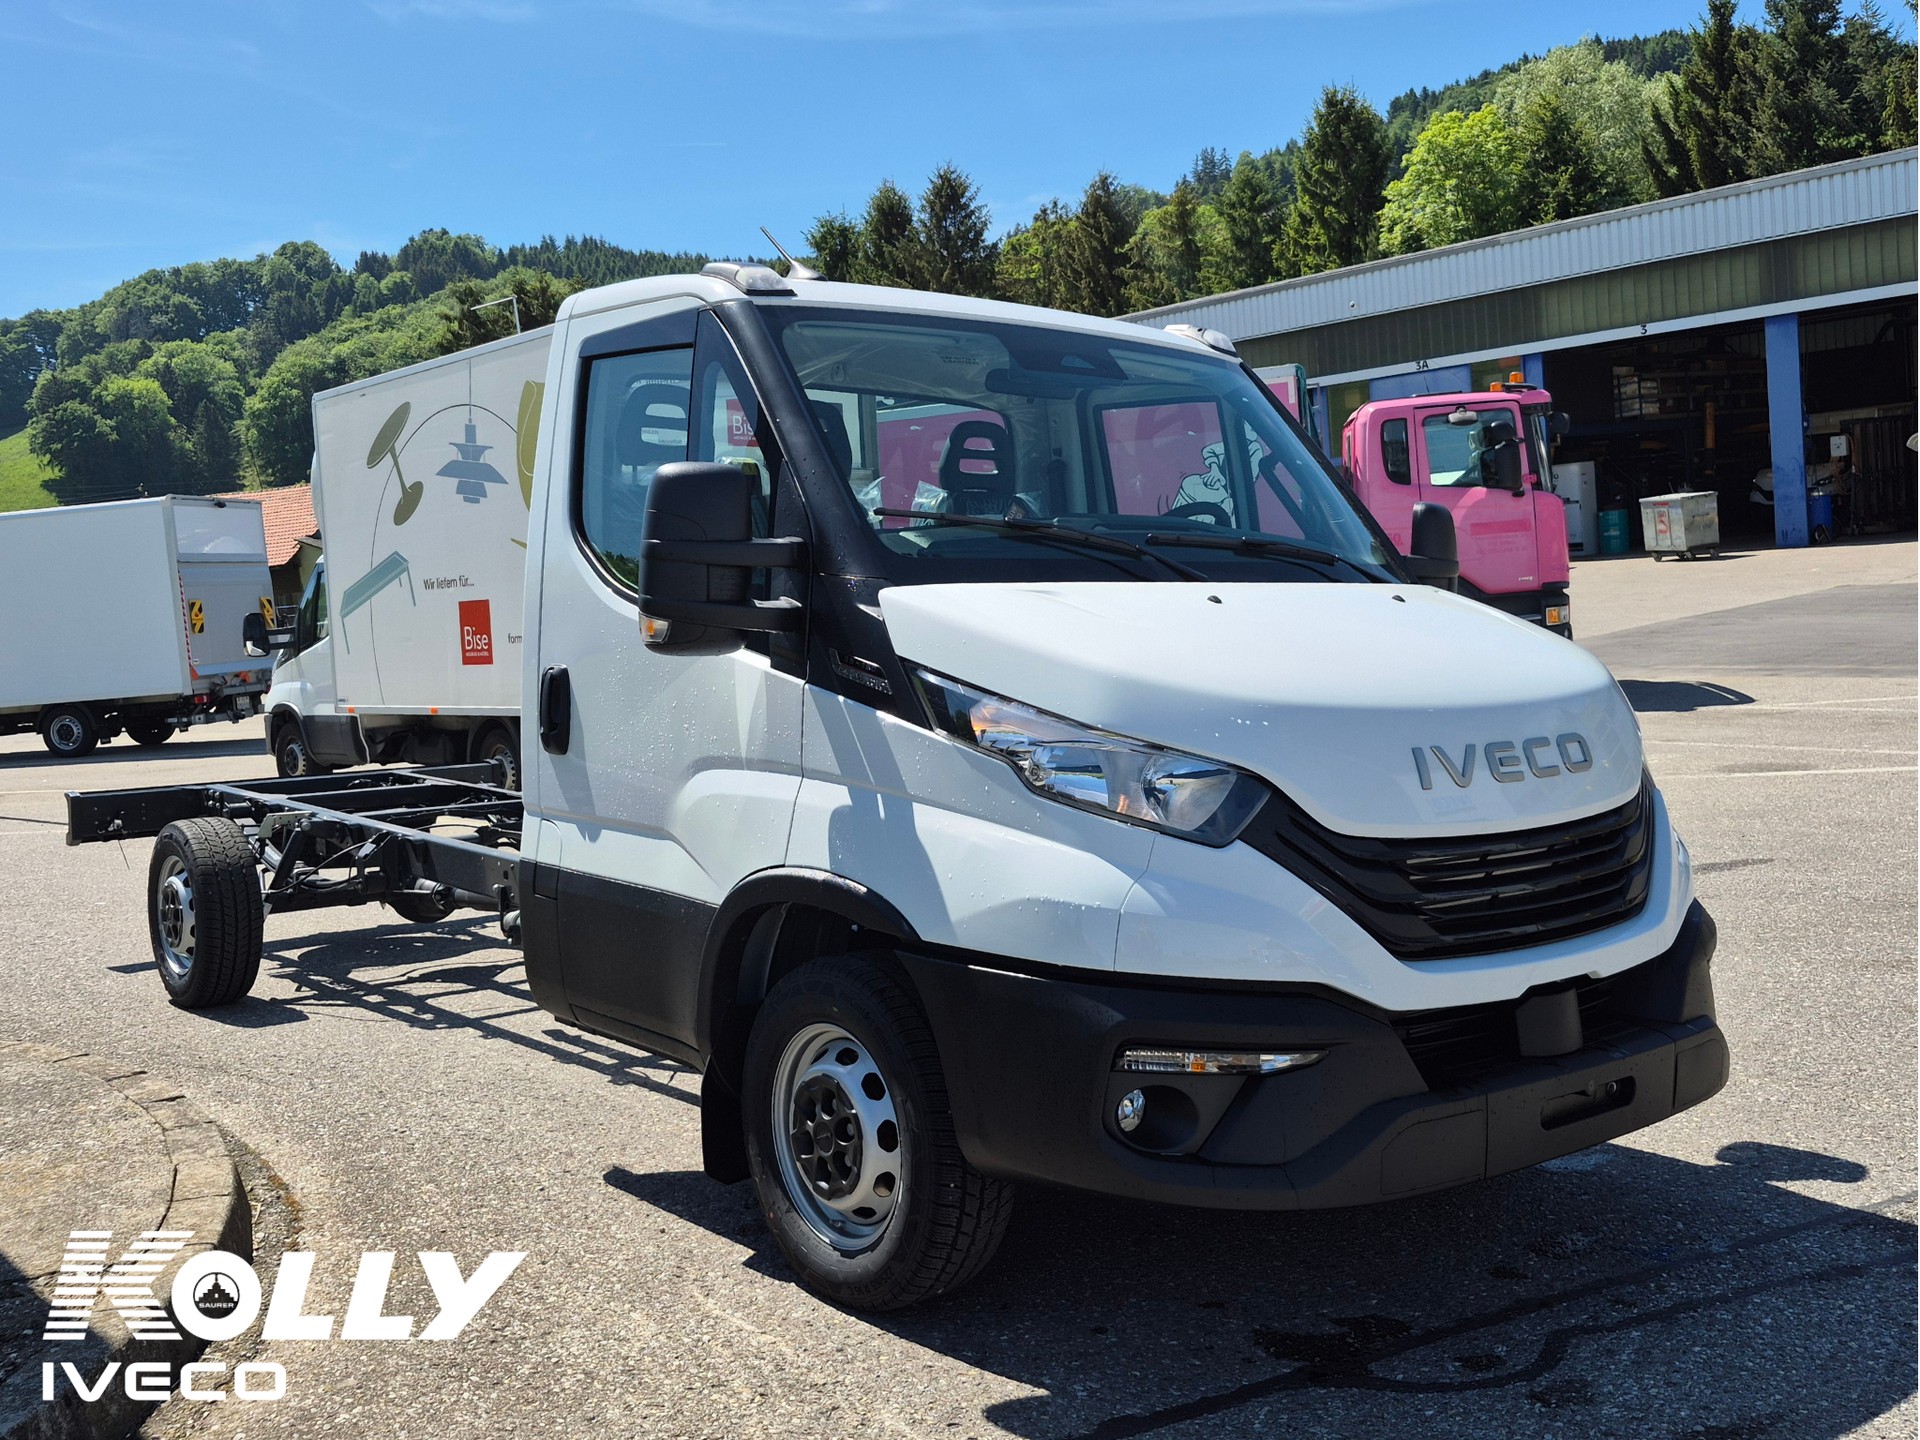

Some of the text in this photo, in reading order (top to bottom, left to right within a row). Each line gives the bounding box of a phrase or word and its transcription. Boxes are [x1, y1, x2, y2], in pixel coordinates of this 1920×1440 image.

[1640, 324, 1648, 335] 3
[1415, 360, 1429, 371] 3A
[423, 578, 435, 590] Wir
[436, 577, 458, 589] liefern
[463, 626, 489, 650] Bise
[1411, 732, 1593, 790] IVECO
